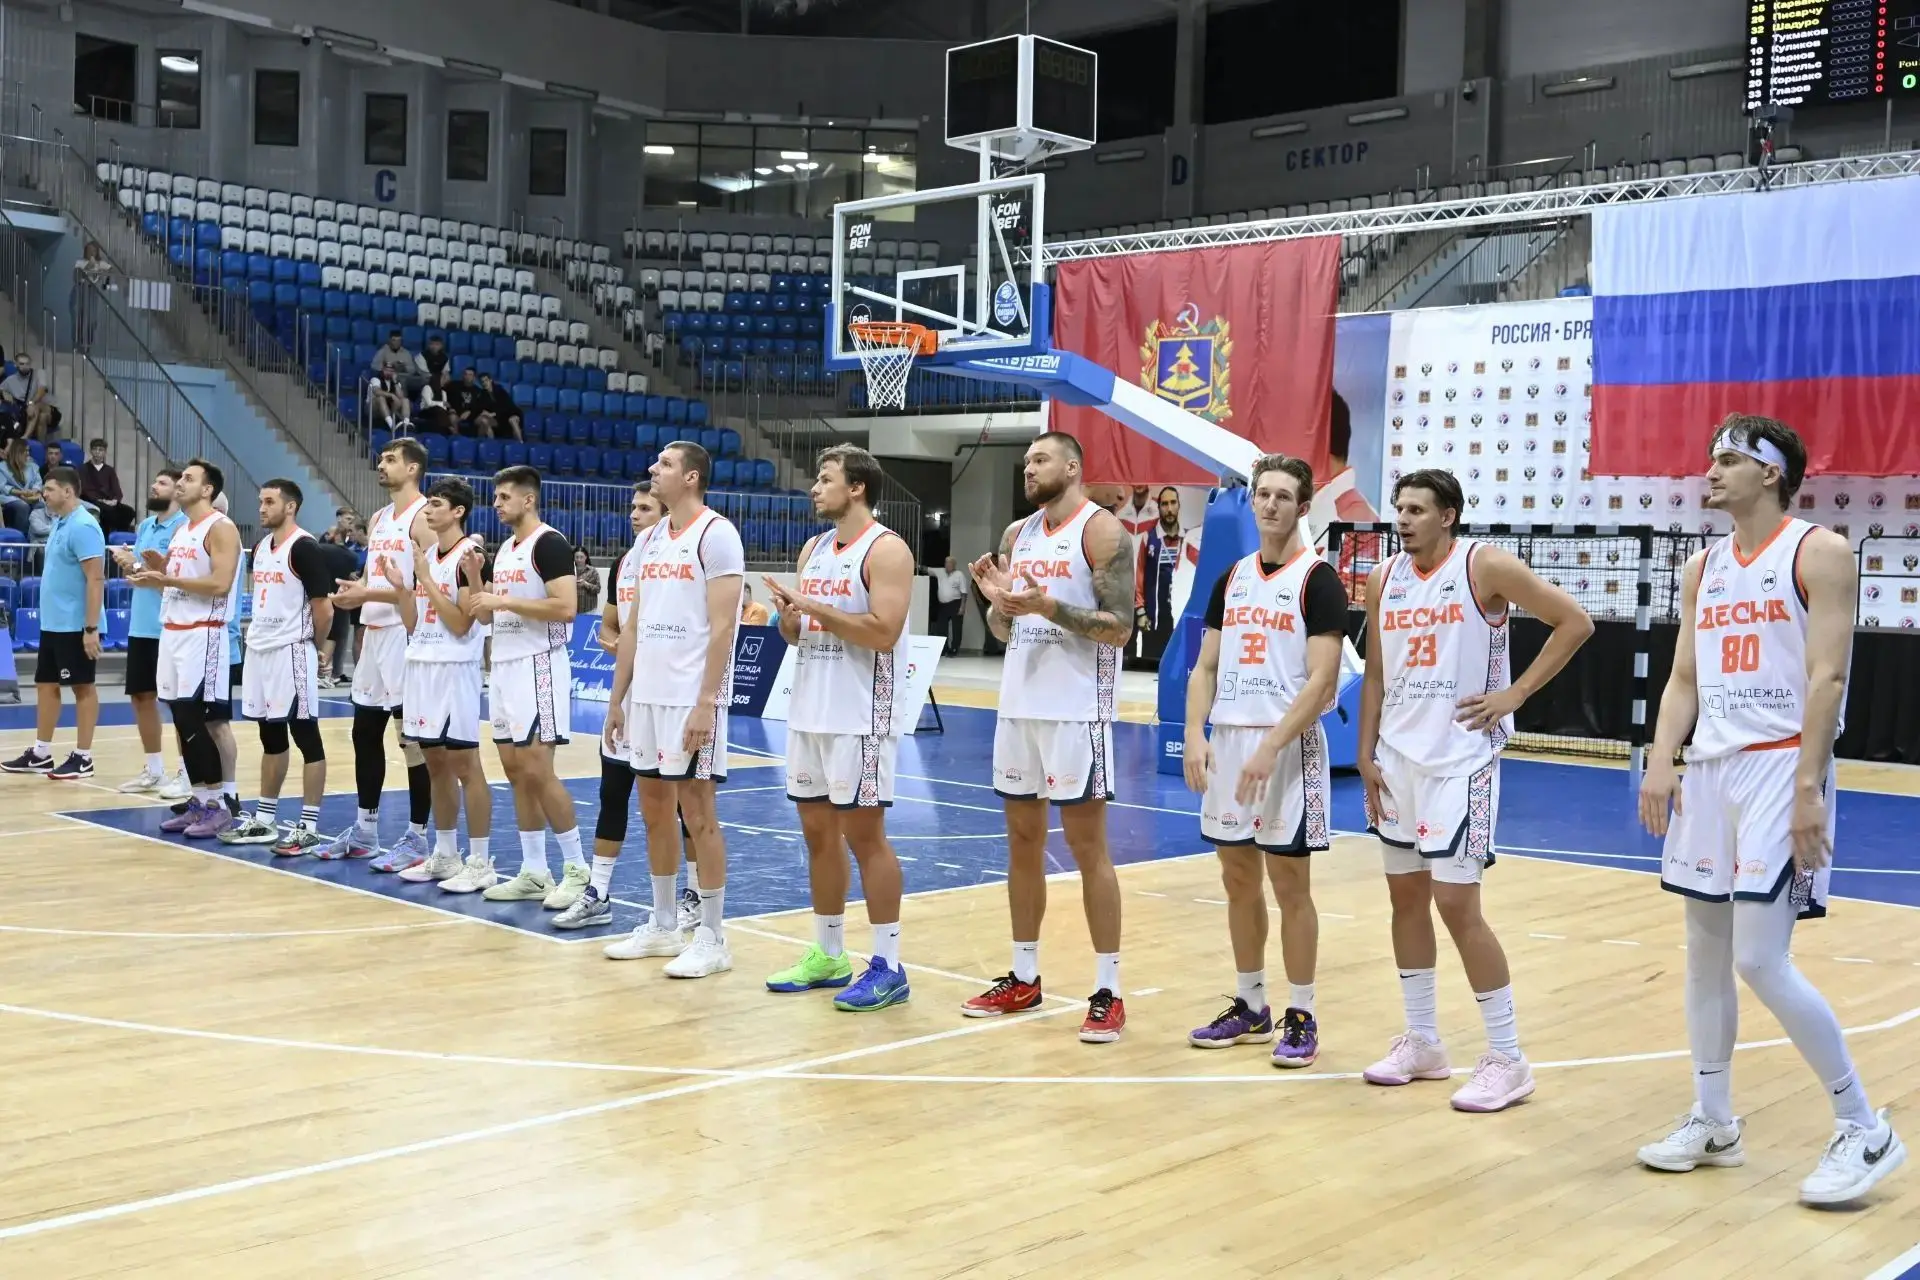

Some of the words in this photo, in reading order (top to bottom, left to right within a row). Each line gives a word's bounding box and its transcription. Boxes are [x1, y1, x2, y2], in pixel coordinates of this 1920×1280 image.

[1772, 7, 1823, 21] Писарчу
[1772, 18, 1820, 32] Шадуро
[1771, 28, 1829, 43] Тукмаков
[1750, 47, 1764, 55] 10
[1771, 40, 1821, 54] Куликов
[1750, 58, 1763, 66] 12
[1770, 51, 1816, 64] Чернов
[1770, 61, 1823, 74] Микульс
[1770, 72, 1823, 85] Коршако
[1902, 74, 1917, 89] 0
[1769, 84, 1812, 96] Глазов
[1286, 141, 1368, 171] СЕКТОР
[1171, 154, 1188, 186] D
[997, 202, 1021, 217] FON
[850, 222, 872, 237] FON
[997, 215, 1021, 230] BET
[850, 235, 872, 250] BET
[1492, 322, 1551, 345] РОССИЯ
[1563, 319, 1594, 341] БРЯ
[170, 546, 198, 561] ЕСНА
[494, 569, 528, 584] ЕСНА
[641, 562, 696, 581] ДЕСНА
[1011, 559, 1073, 580] ДЕСНА
[253, 571, 286, 585] ЕСНА
[27, 610, 37, 620] 14
[1222, 605, 1296, 634] ДЕСНА
[1382, 603, 1465, 631] ДЕСНА
[1697, 599, 1792, 630] ДЕСНА
[1406, 633, 1437, 668] 33
[1722, 633, 1760, 674] 80
[1728, 688, 1793, 700] НАДЕЖДА
[1165, 741, 1185, 753] SP
